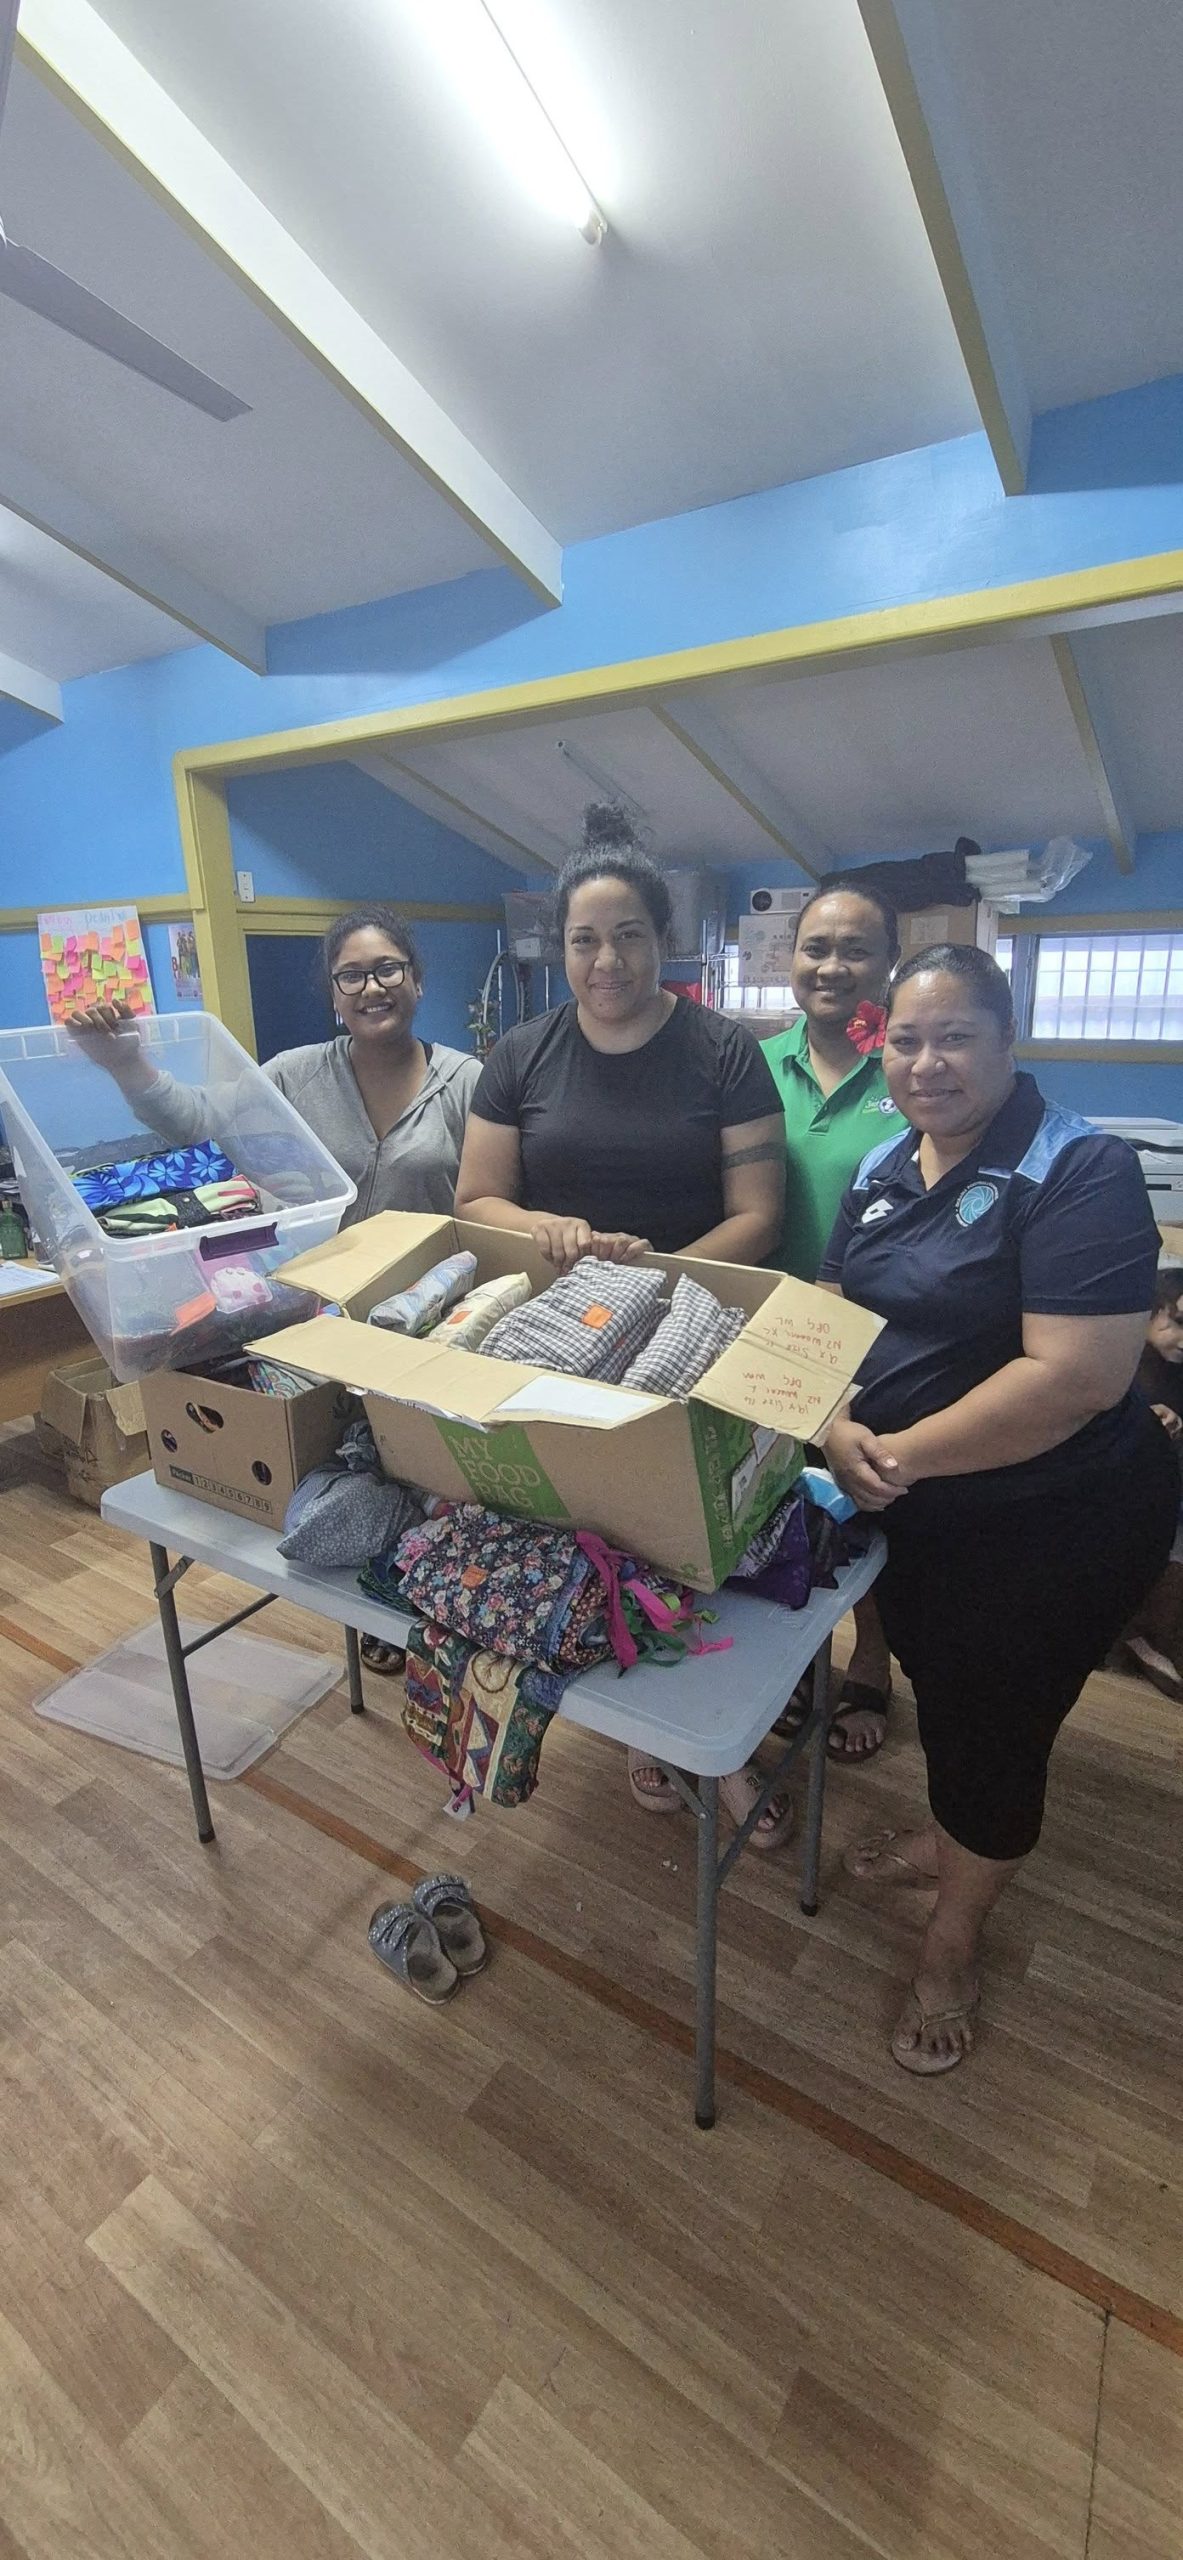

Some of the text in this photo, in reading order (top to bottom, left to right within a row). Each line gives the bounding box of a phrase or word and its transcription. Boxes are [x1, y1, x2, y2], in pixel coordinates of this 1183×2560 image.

[447, 1435, 493, 1461] MY
[461, 1459, 540, 1488] FOOD
[475, 1481, 535, 1509] BAG
